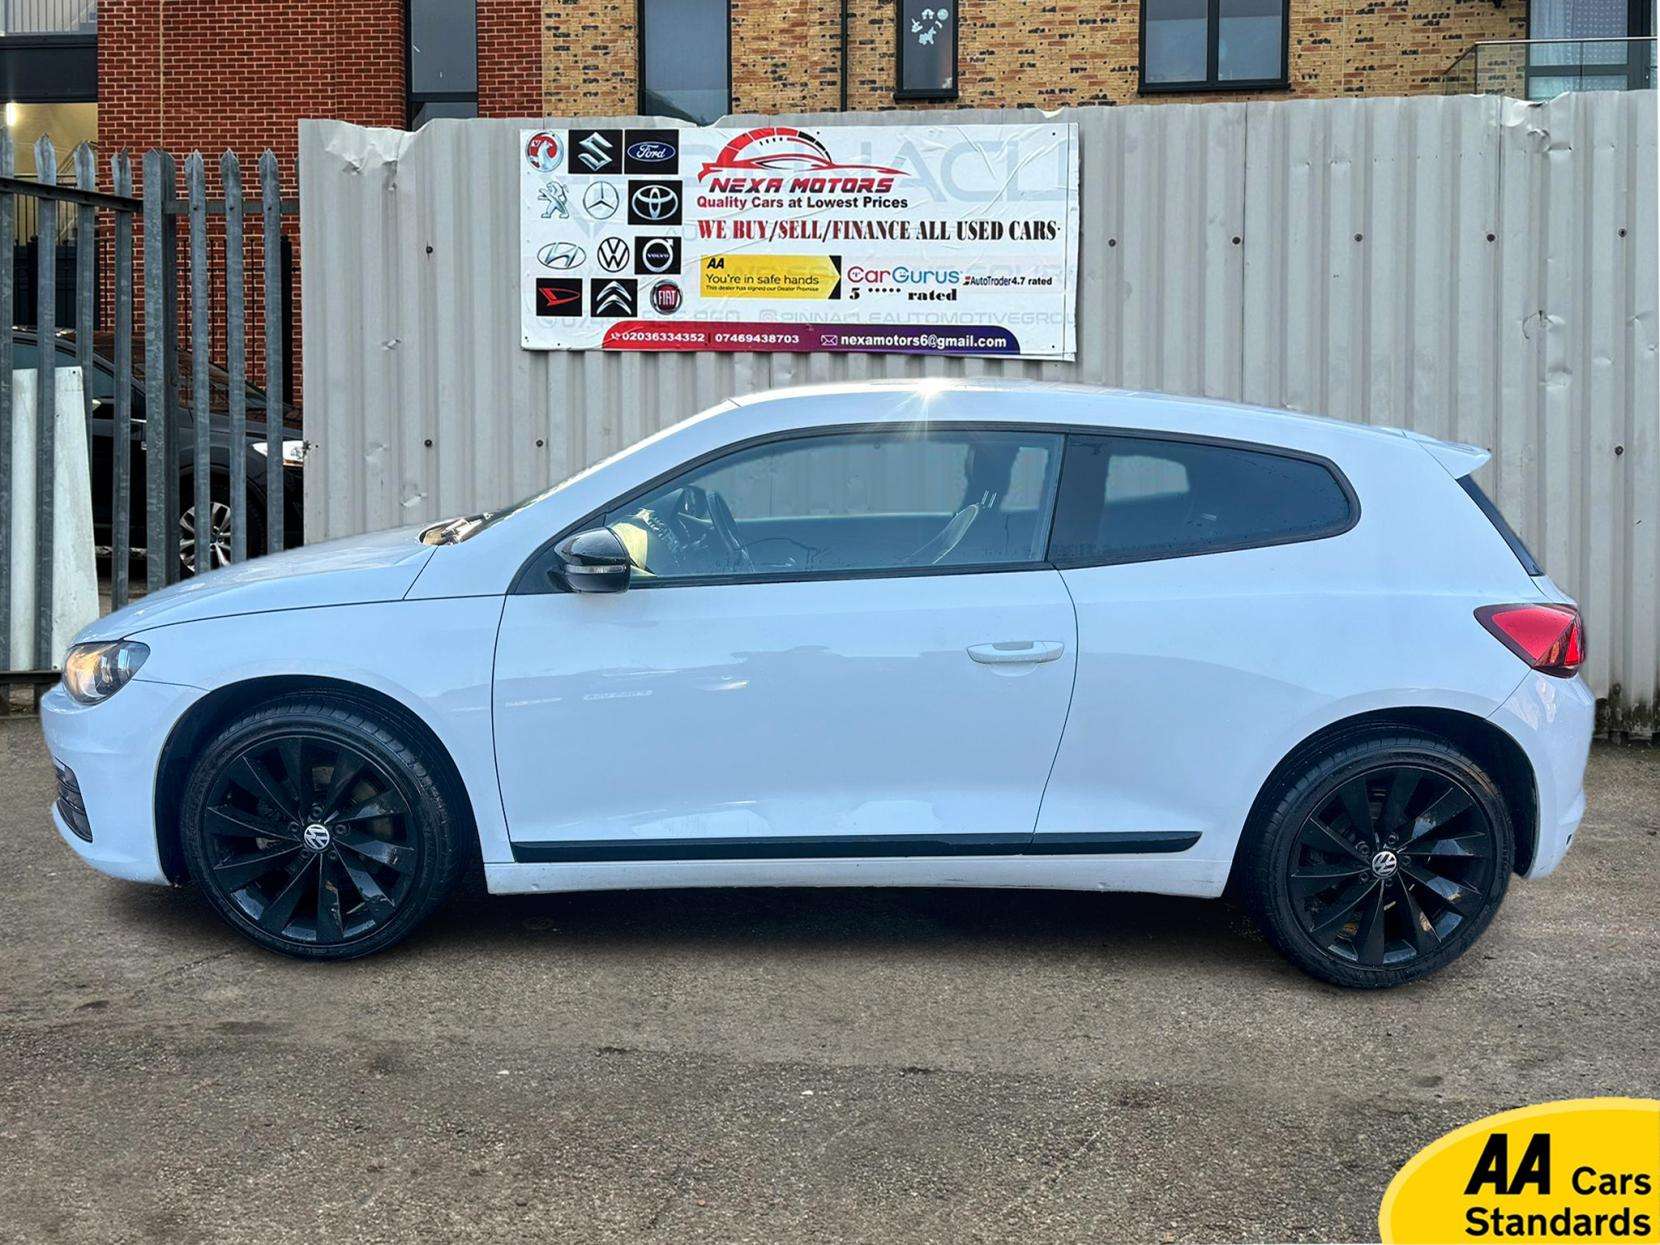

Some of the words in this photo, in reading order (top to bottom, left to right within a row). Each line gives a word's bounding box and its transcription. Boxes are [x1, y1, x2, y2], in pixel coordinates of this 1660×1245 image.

[636, 144, 666, 158] Ford
[708, 178, 784, 194] NEXA
[789, 178, 895, 194] MOTORS
[697, 196, 747, 211] Quality
[752, 196, 784, 208] Cars
[788, 197, 803, 208] at
[807, 196, 859, 208] Lowest
[863, 197, 908, 208] Prices
[698, 220, 727, 239] WE
[733, 219, 911, 243] BUY/SELL/FINANCE
[916, 220, 951, 240] ALL
[956, 220, 1004, 240] USED
[1008, 220, 1057, 240] CARS
[707, 257, 725, 269] AA
[706, 273, 741, 284] You're
[744, 274, 754, 284] in
[757, 274, 781, 285] safe
[784, 274, 820, 285] hands
[847, 266, 960, 284] CarGurus
[1027, 276, 1053, 285] rated
[658, 290, 677, 306] FIAT
[849, 287, 861, 300] 5
[908, 288, 958, 301] rated
[622, 332, 706, 342] 02036334352
[715, 333, 800, 343] 07469438703
[840, 334, 1007, 349] nexamotors6@gmail.com
